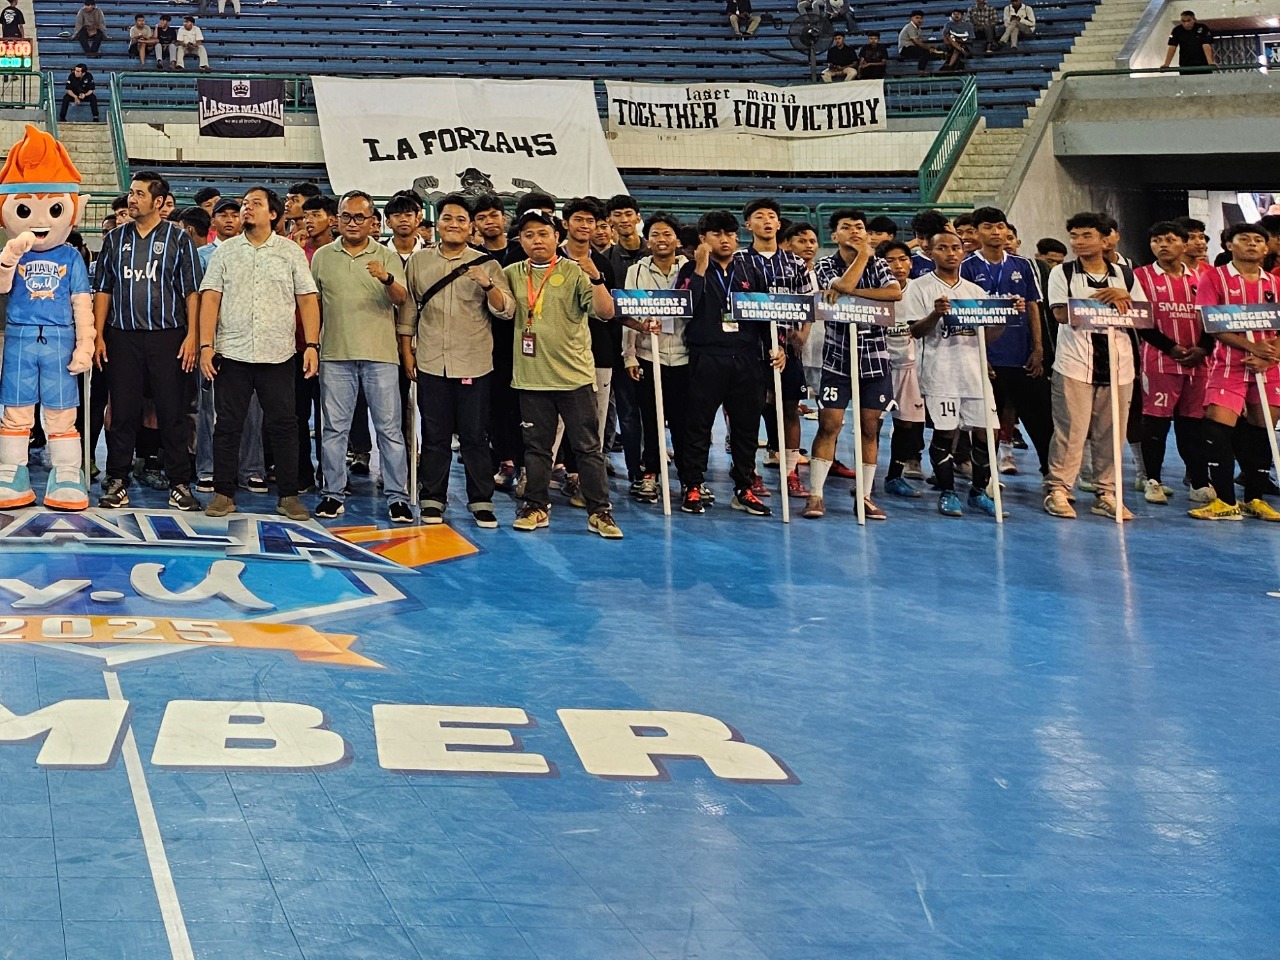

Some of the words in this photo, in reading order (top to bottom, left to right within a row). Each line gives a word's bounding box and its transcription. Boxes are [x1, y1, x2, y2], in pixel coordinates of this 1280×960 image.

[686, 88, 730, 102] laser
[747, 89, 797, 104] mania
[613, 99, 719, 129] TOGETHER
[733, 100, 776, 130] FOR
[782, 98, 880, 131] VICTORY
[362, 138, 418, 162] LA
[25, 262, 60, 278] PIALA
[123, 259, 158, 282] by.U
[616, 297, 638, 306] SMA
[640, 297, 680, 306] NEGERI
[680, 297, 688, 306] 2
[736, 300, 759, 310] SMK
[760, 301, 802, 312] NEGERI
[802, 303, 811, 312] 4
[621, 306, 685, 315] BONDOWOSO
[741, 309, 807, 321] BONDOWOSO
[817, 301, 840, 312] SMA
[841, 303, 882, 316] NEGERI
[883, 307, 891, 316] 1
[1073, 306, 1097, 316] SMA
[1098, 307, 1140, 318] NEGRI
[1140, 309, 1149, 318] 2
[832, 311, 876, 324] JEMBER
[957, 315, 1007, 324] THALABAH
[1090, 316, 1135, 326] JEMBER
[1207, 312, 1232, 322] SMA
[1232, 310, 1277, 321] NEGERI
[1225, 320, 1273, 330] JEMBER
[823, 386, 839, 402] 25
[1154, 392, 1169, 408] 21
[940, 401, 957, 418] 14
